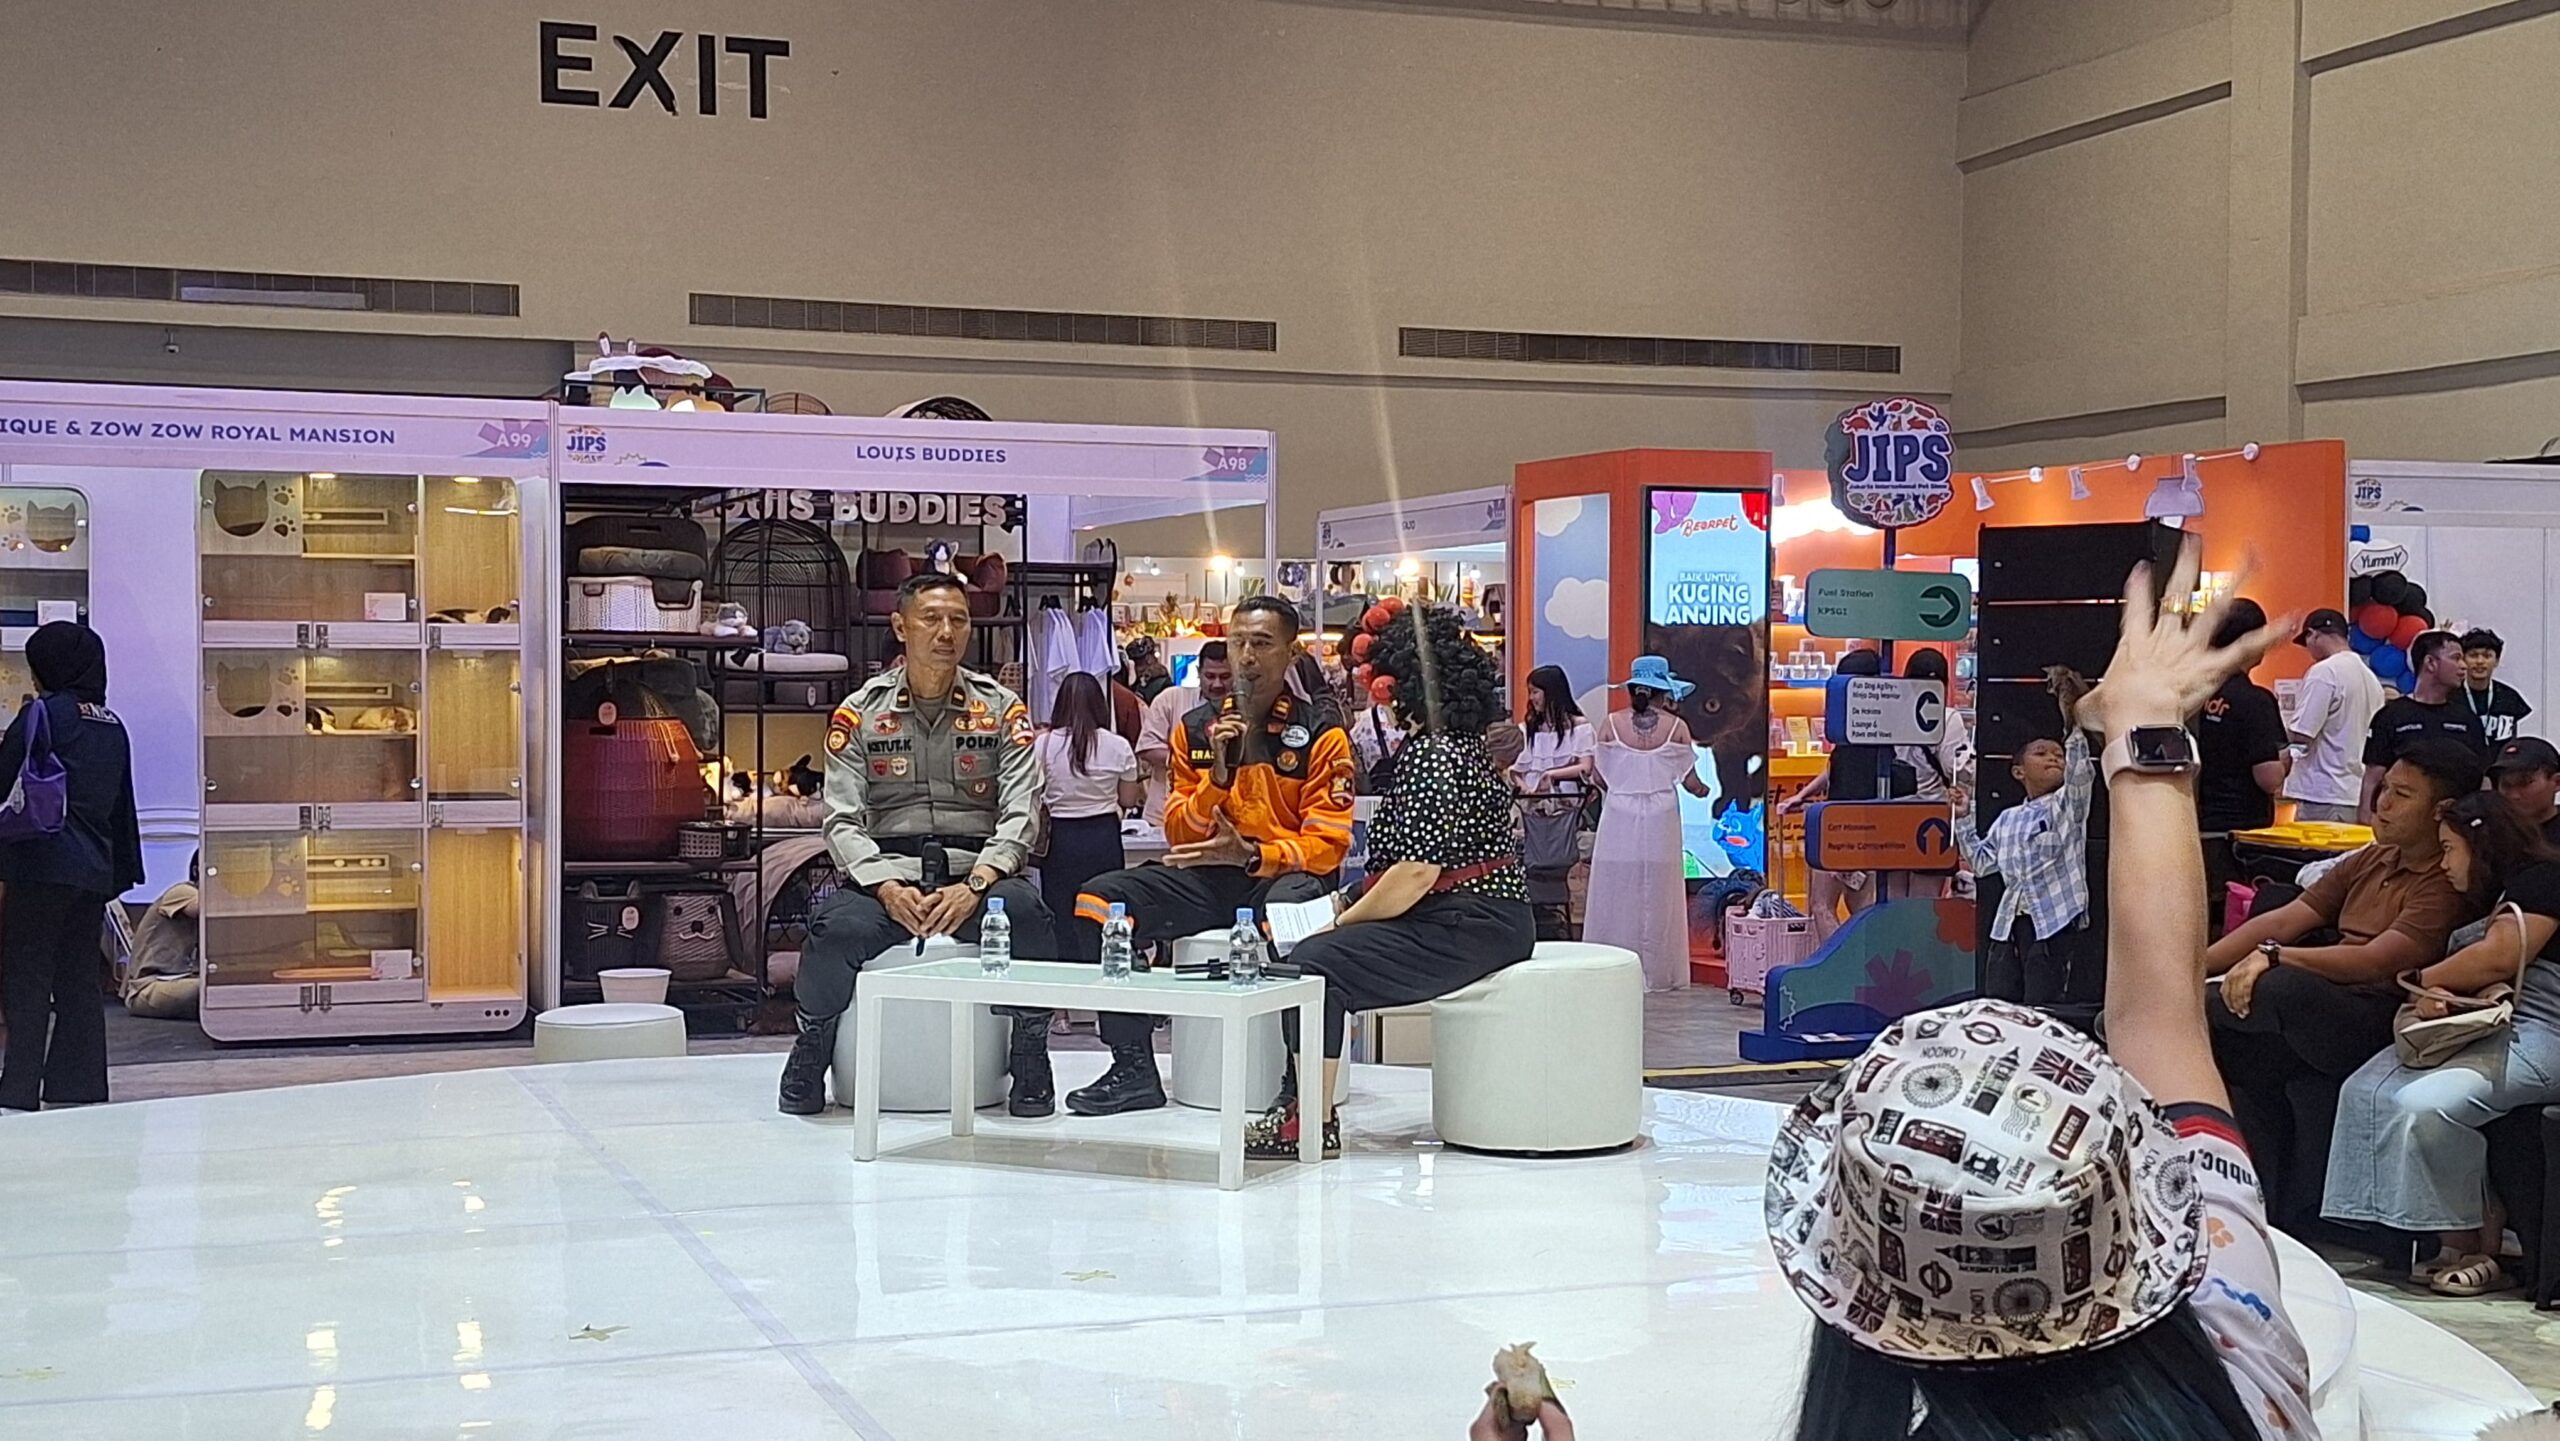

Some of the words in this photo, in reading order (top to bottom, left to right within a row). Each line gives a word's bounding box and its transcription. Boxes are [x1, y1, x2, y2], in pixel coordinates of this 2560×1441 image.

[540, 20, 790, 119] EXIT
[66, 420, 81, 435] &
[90, 421, 143, 437] ZOW
[151, 423, 203, 439] ZOW
[211, 425, 281, 441] ROYAL
[289, 427, 395, 444] MANSION
[496, 432, 532, 448] A99
[566, 435, 607, 452] JIPS
[857, 446, 916, 462] LOUIS
[922, 447, 1007, 463] BUDDIES
[1844, 433, 1950, 482] JIPS
[1217, 456, 1247, 471] A98
[2354, 486, 2383, 501] JIPS
[832, 491, 1006, 527] BUDDIES
[1680, 573, 1701, 582] BAIK
[1704, 573, 1738, 583] UNTUK
[1668, 584, 1750, 604] KUCING
[1818, 588, 1838, 597] Fuel
[1840, 588, 1874, 598] Station
[1666, 605, 1752, 625] ANJING
[955, 736, 999, 750] POLRI
